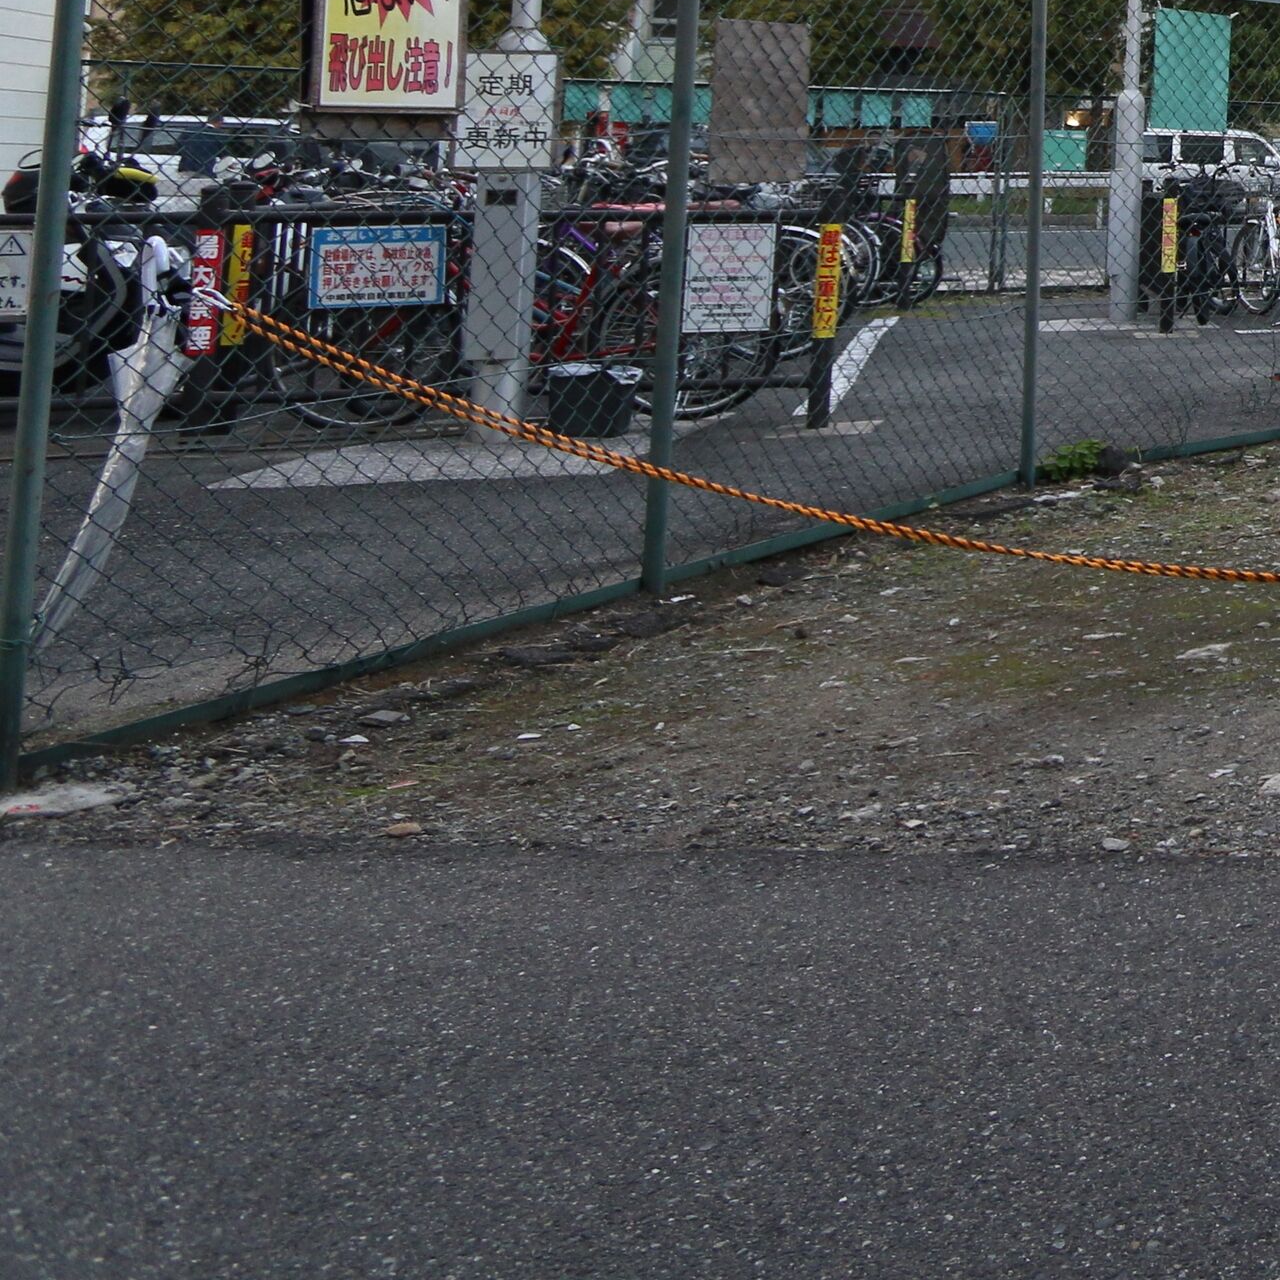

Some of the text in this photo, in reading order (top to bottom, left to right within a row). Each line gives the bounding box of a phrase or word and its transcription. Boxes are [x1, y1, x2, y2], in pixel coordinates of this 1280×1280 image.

[328, 33, 453, 95] 飛び出し注意！
[479, 74, 534, 96] 定期
[464, 127, 548, 150] 更新中
